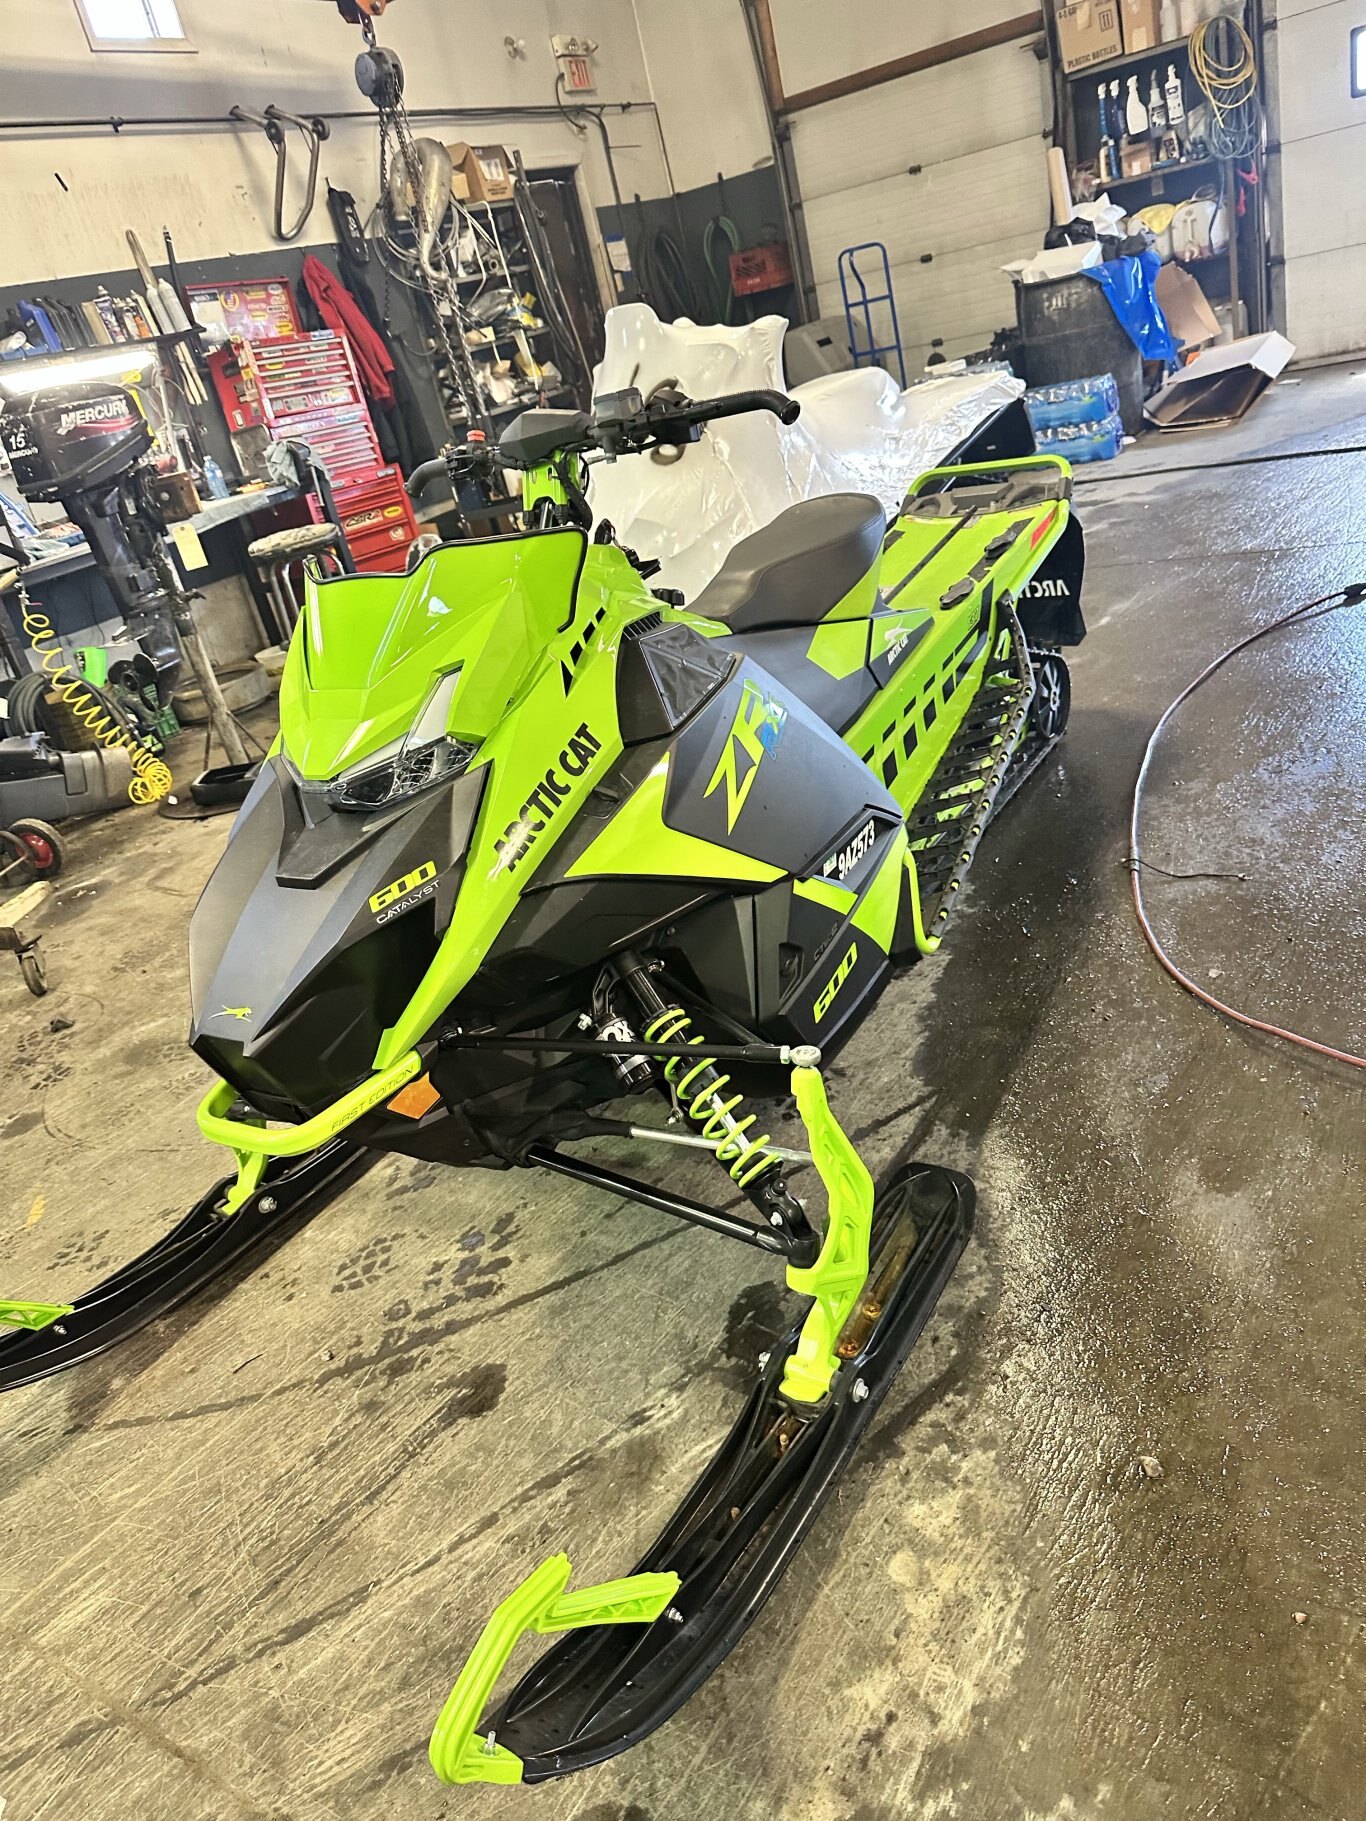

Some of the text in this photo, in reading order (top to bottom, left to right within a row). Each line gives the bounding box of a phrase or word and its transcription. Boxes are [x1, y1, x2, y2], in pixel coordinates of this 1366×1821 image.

[568, 59, 591, 88] EXIT
[1067, 44, 1118, 69] PLASTIC BOTTLES
[9, 433, 26, 450] 15
[493, 722, 602, 873] ARCTIC CAT
[837, 819, 875, 880] 9AZ573
[368, 860, 437, 914] 600
[376, 879, 440, 924] CATALYST
[813, 941, 858, 1024] 600
[331, 1065, 414, 1132] FIRST EDITION
